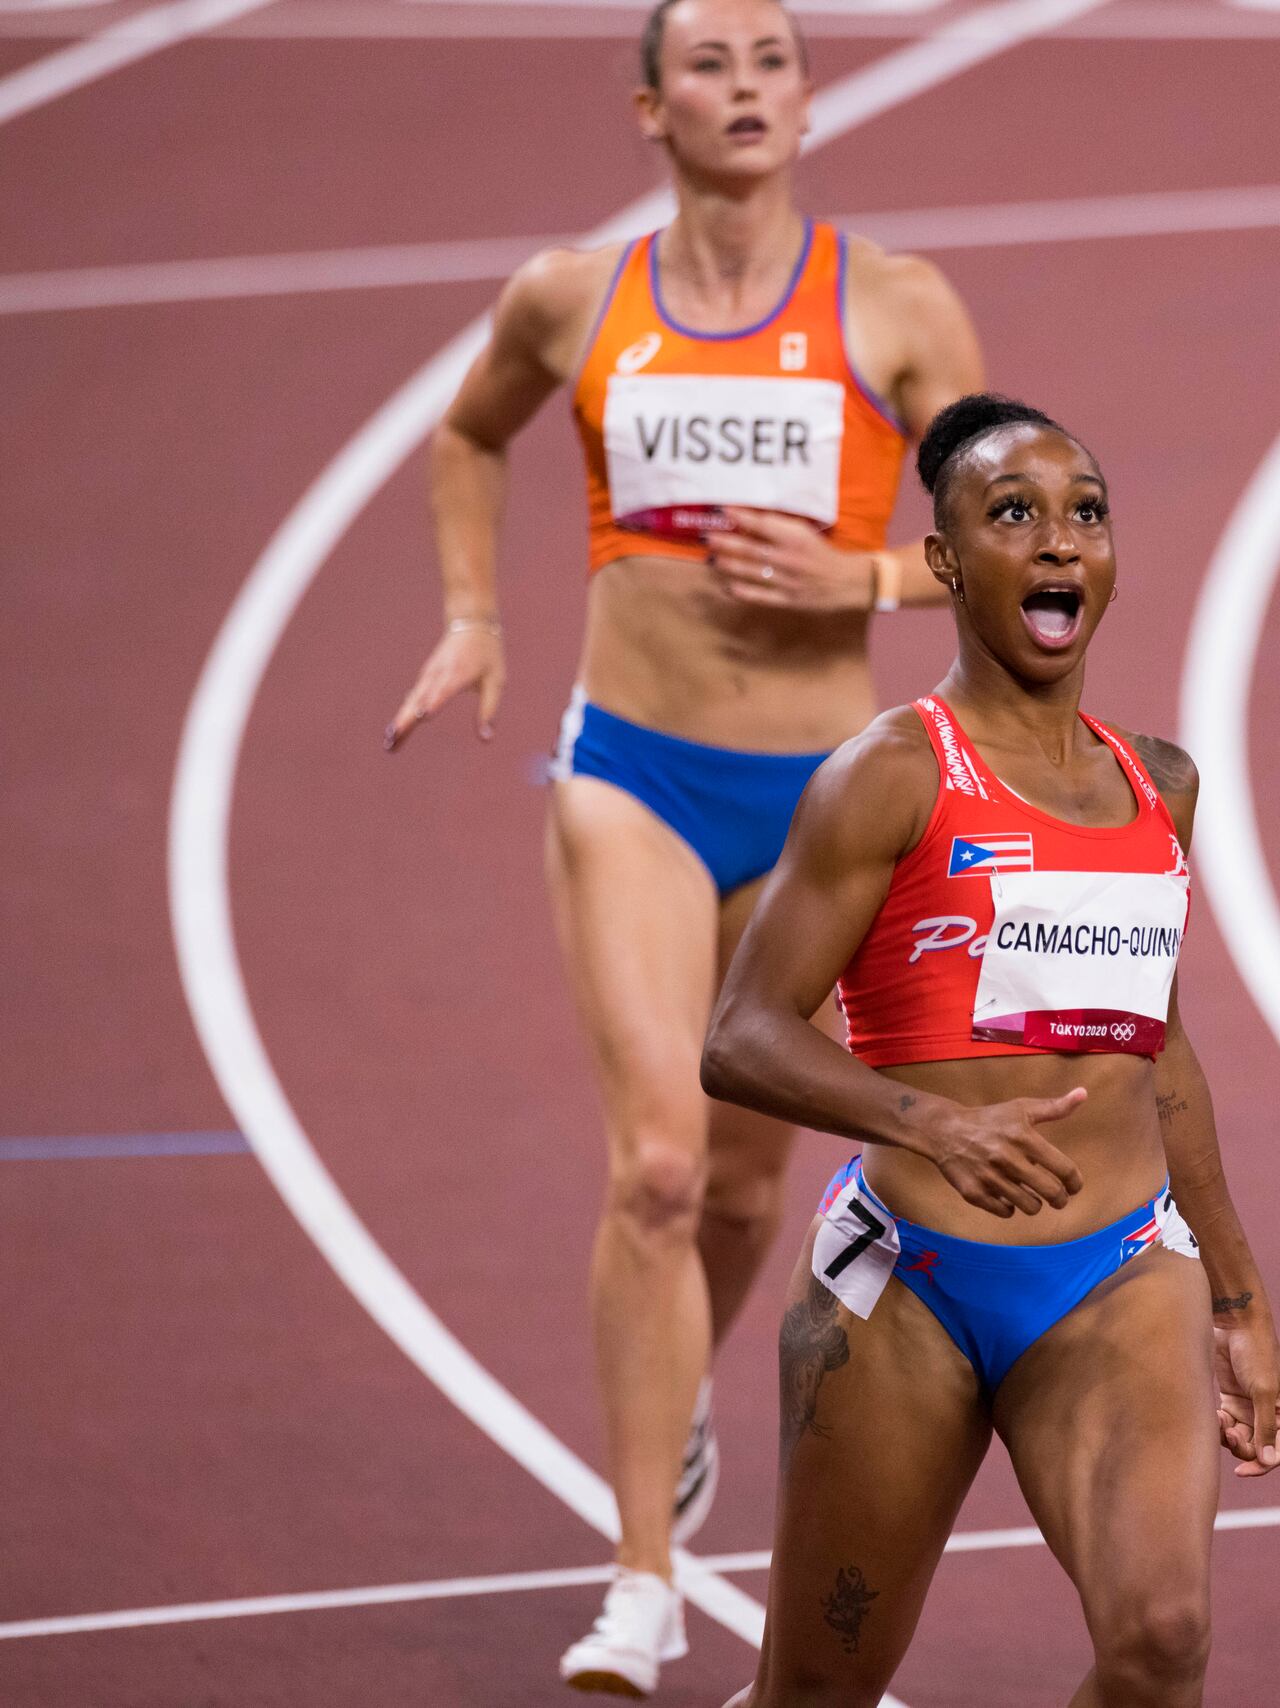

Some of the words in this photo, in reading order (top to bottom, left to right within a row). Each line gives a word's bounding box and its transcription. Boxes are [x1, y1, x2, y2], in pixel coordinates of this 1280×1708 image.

[636, 416, 809, 465] VISSER
[1049, 1022, 1086, 1037] TOKYO
[1086, 1024, 1108, 1037] 2020
[823, 1196, 887, 1281] 7
